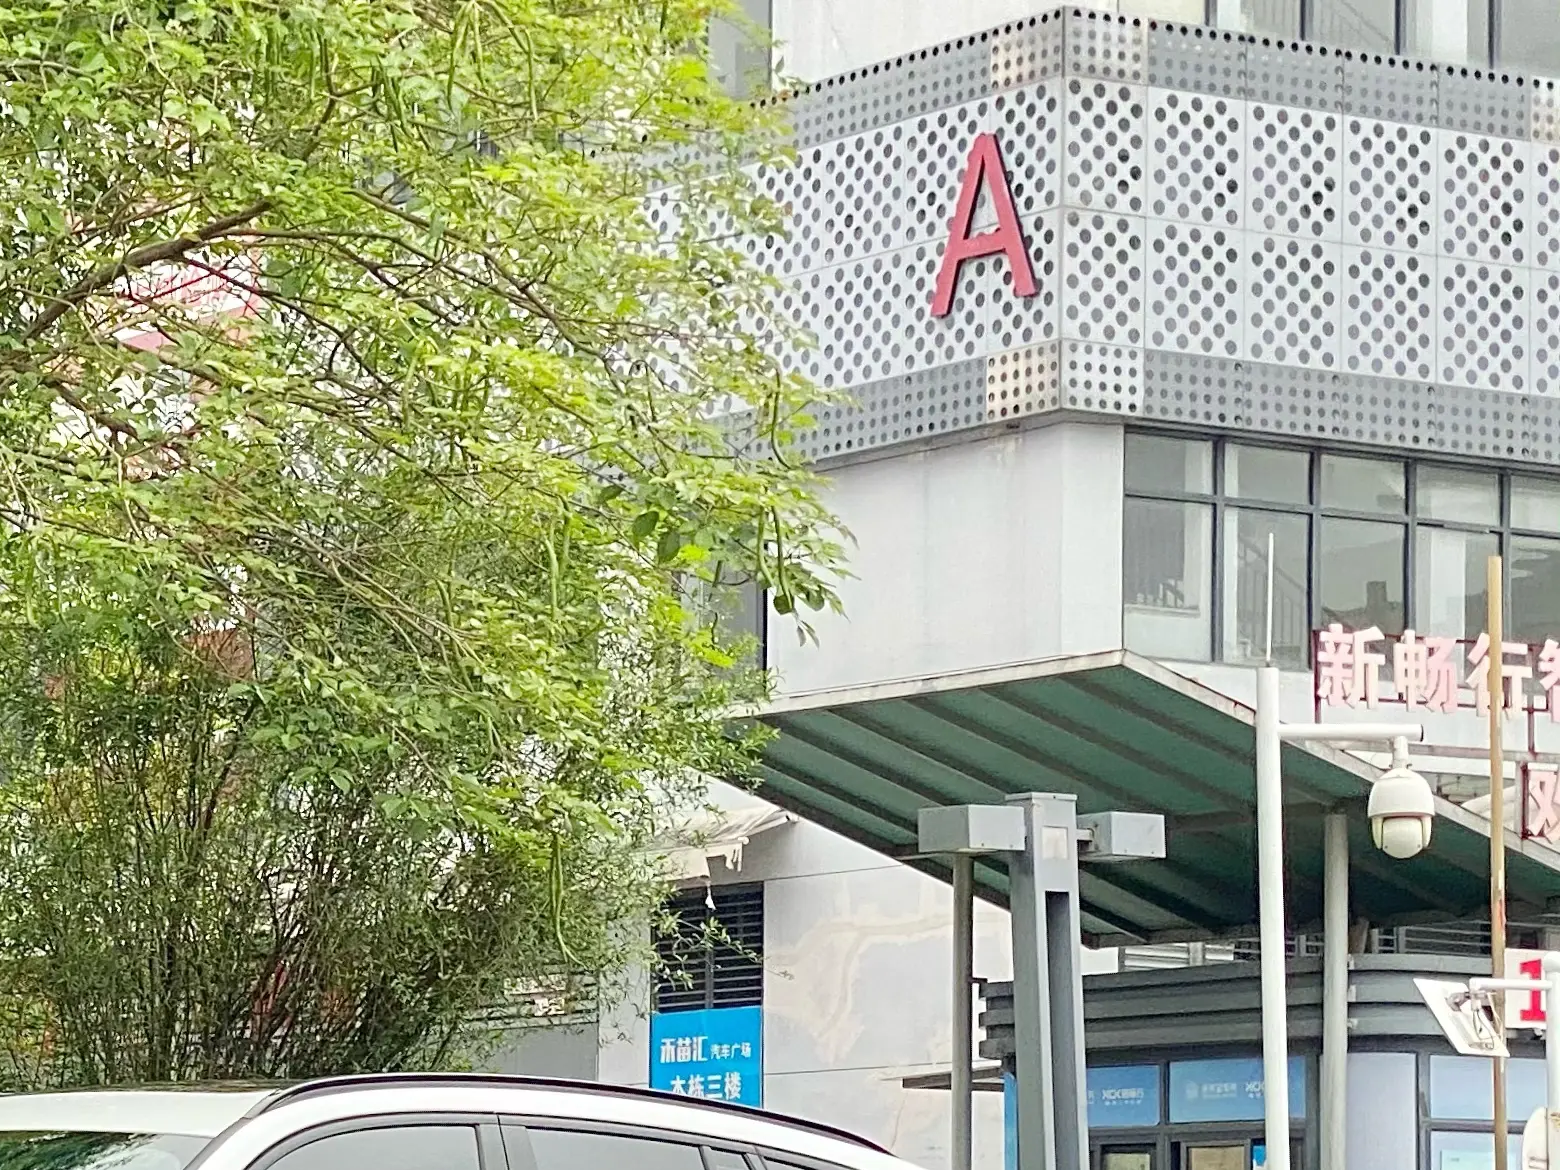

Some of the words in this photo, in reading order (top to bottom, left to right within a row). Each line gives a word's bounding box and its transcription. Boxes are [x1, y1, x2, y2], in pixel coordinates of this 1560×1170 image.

[930, 132, 1037, 318] A
[710, 1042, 752, 1060] 汽车广场
